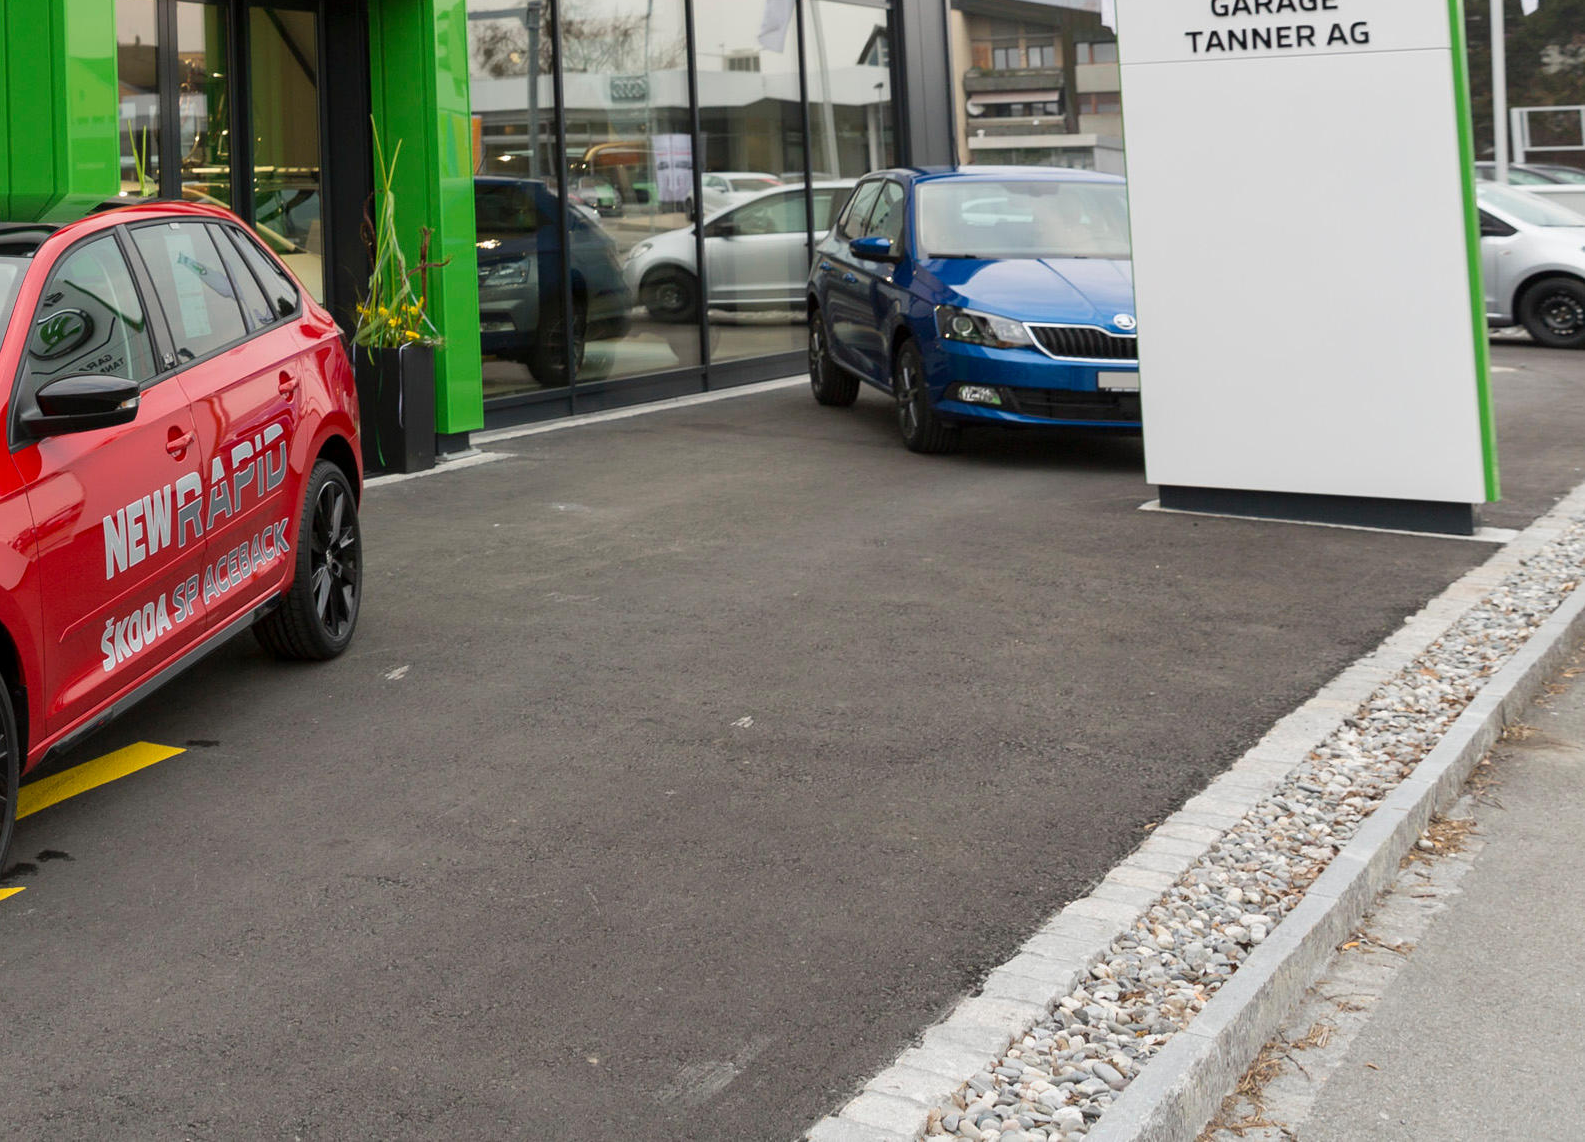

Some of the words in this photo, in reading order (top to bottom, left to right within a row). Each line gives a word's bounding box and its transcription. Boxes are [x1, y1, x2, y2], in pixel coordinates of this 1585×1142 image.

[1185, 24, 1315, 54] TANNER
[1326, 20, 1370, 46] AG
[103, 484, 171, 581] NEW
[175, 423, 287, 548] RAPID
[101, 594, 173, 672] ŠKODA
